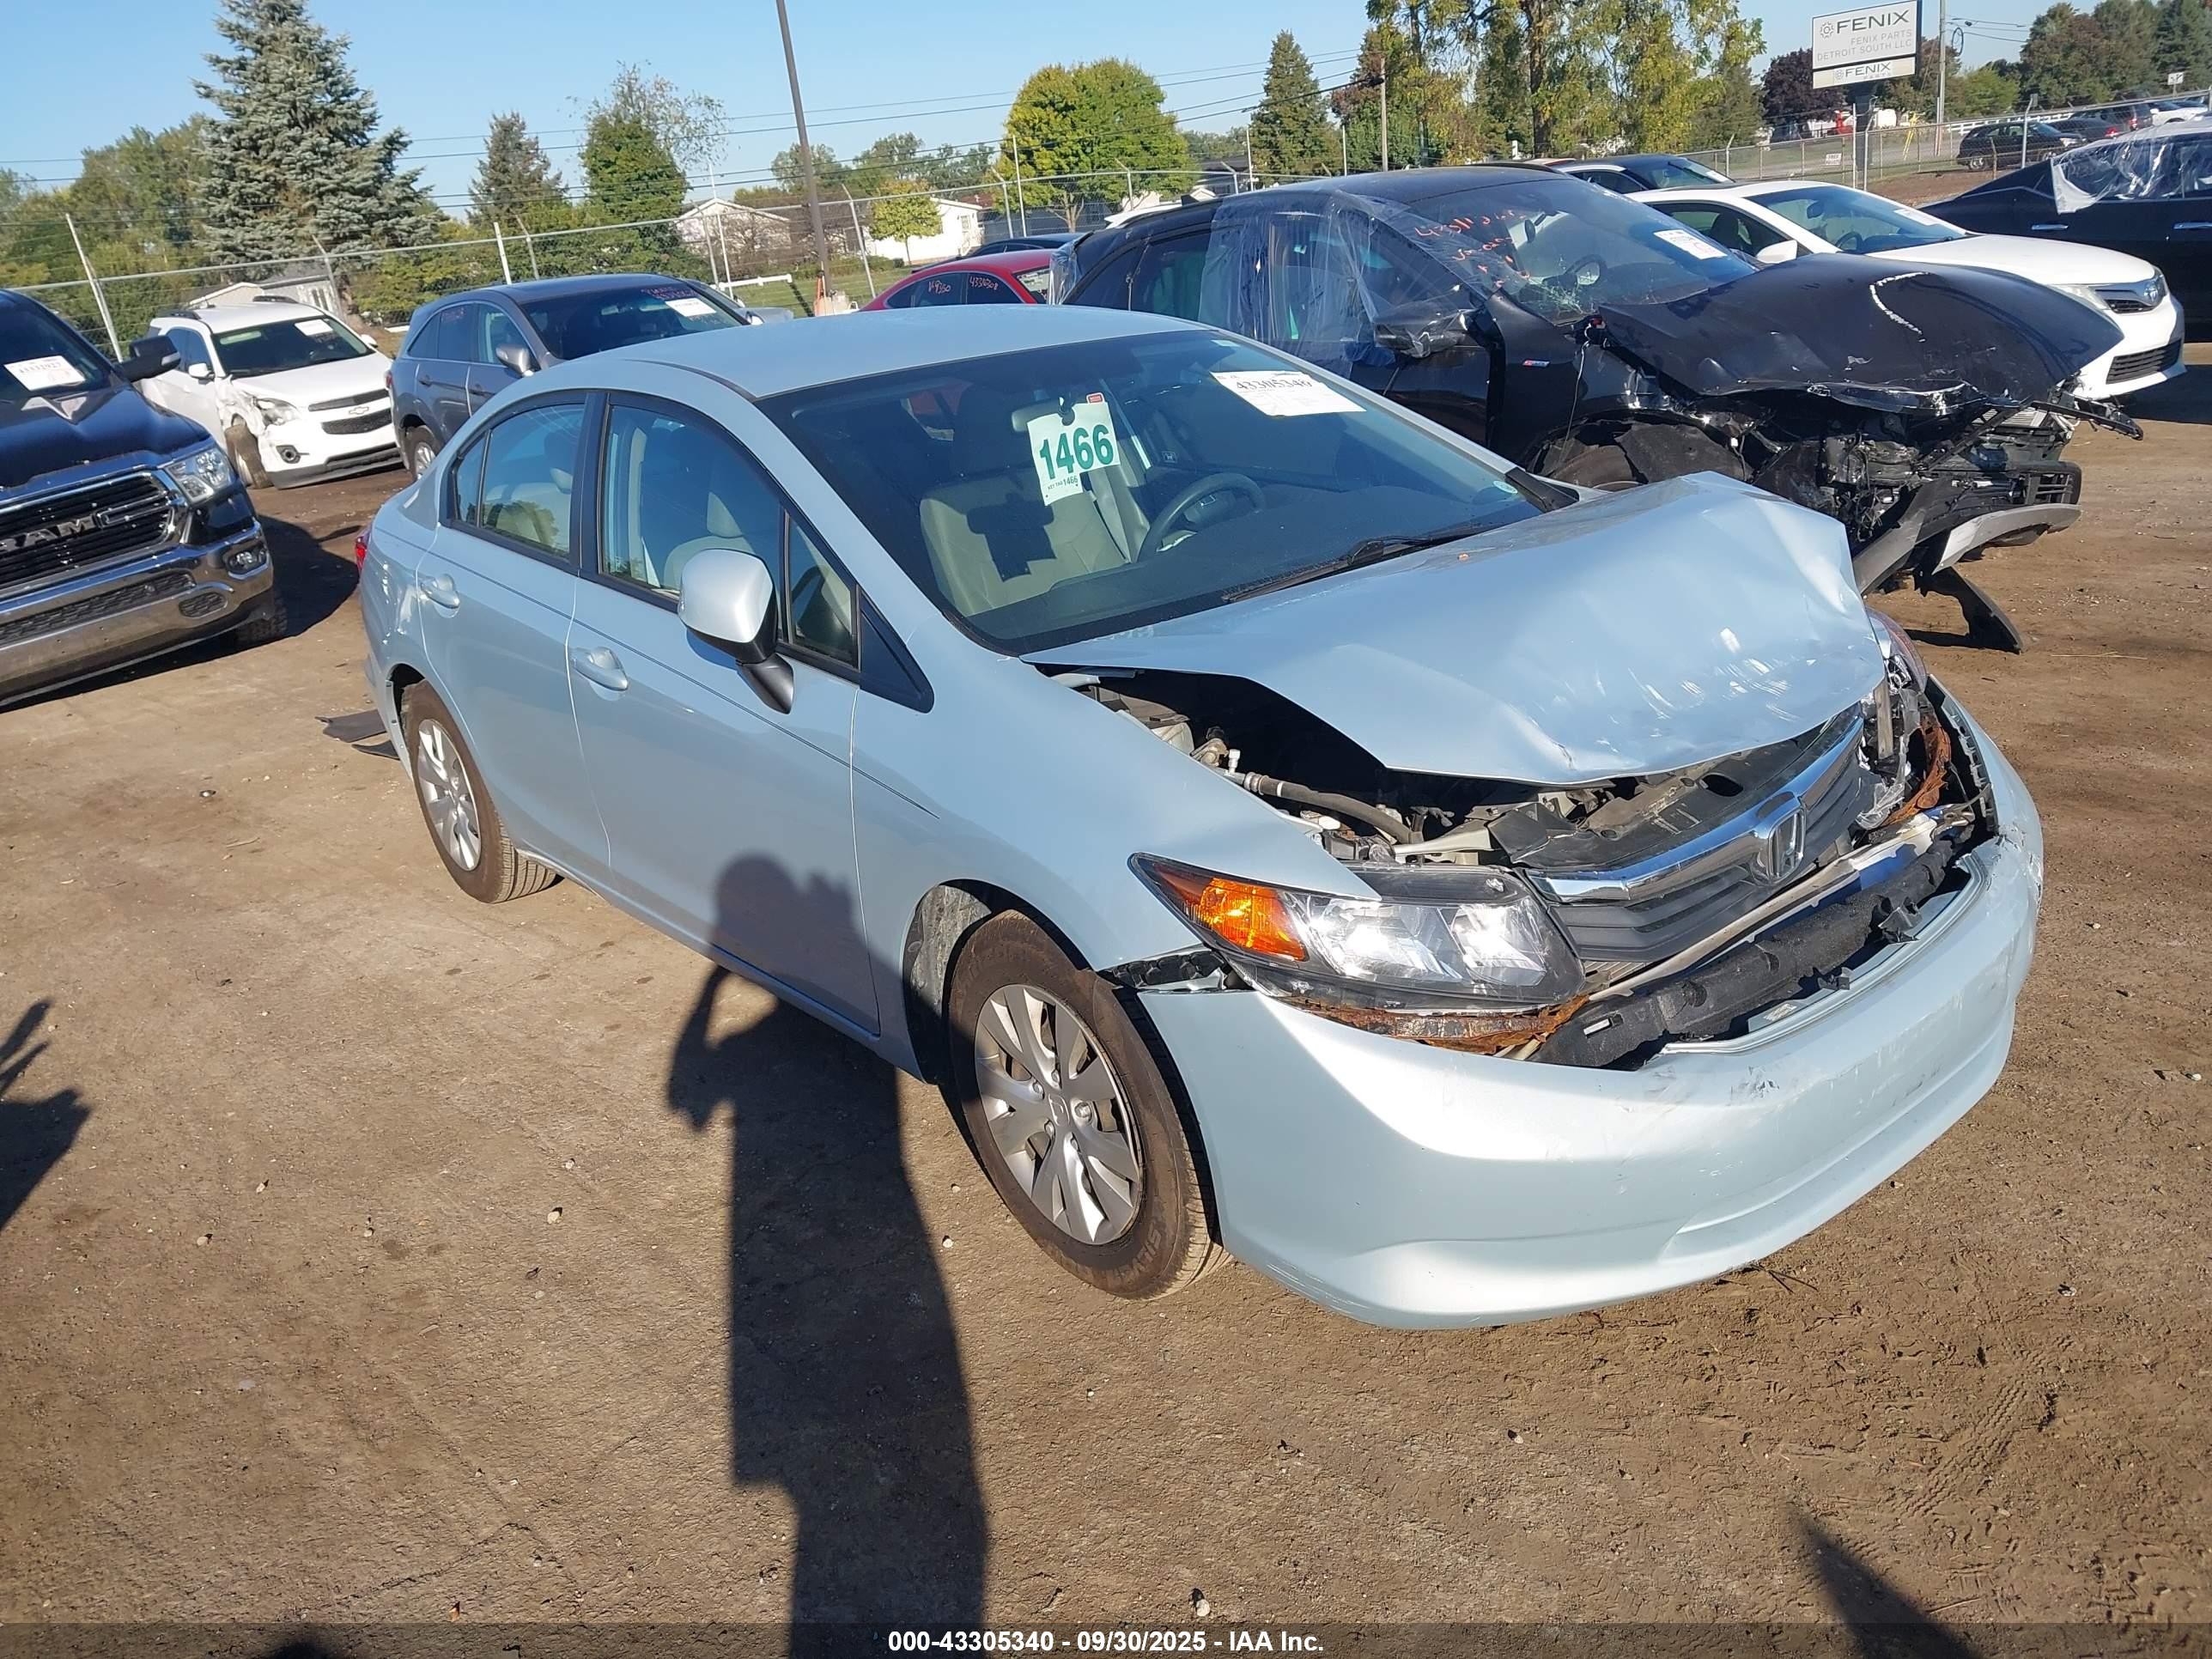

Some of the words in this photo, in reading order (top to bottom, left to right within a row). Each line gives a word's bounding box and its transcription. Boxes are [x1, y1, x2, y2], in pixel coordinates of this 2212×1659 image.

[1837, 9, 1910, 33] FENIX
[1850, 35, 1878, 46] FENIX
[1881, 28, 1912, 40] PARTS
[1817, 47, 1856, 61] DETROIT
[1860, 42, 1892, 54] SOUTH
[1894, 40, 1911, 49] LLC
[1845, 62, 1891, 77] FENIX
[1039, 424, 1115, 479] 1466
[1063, 476, 1079, 486] 1466
